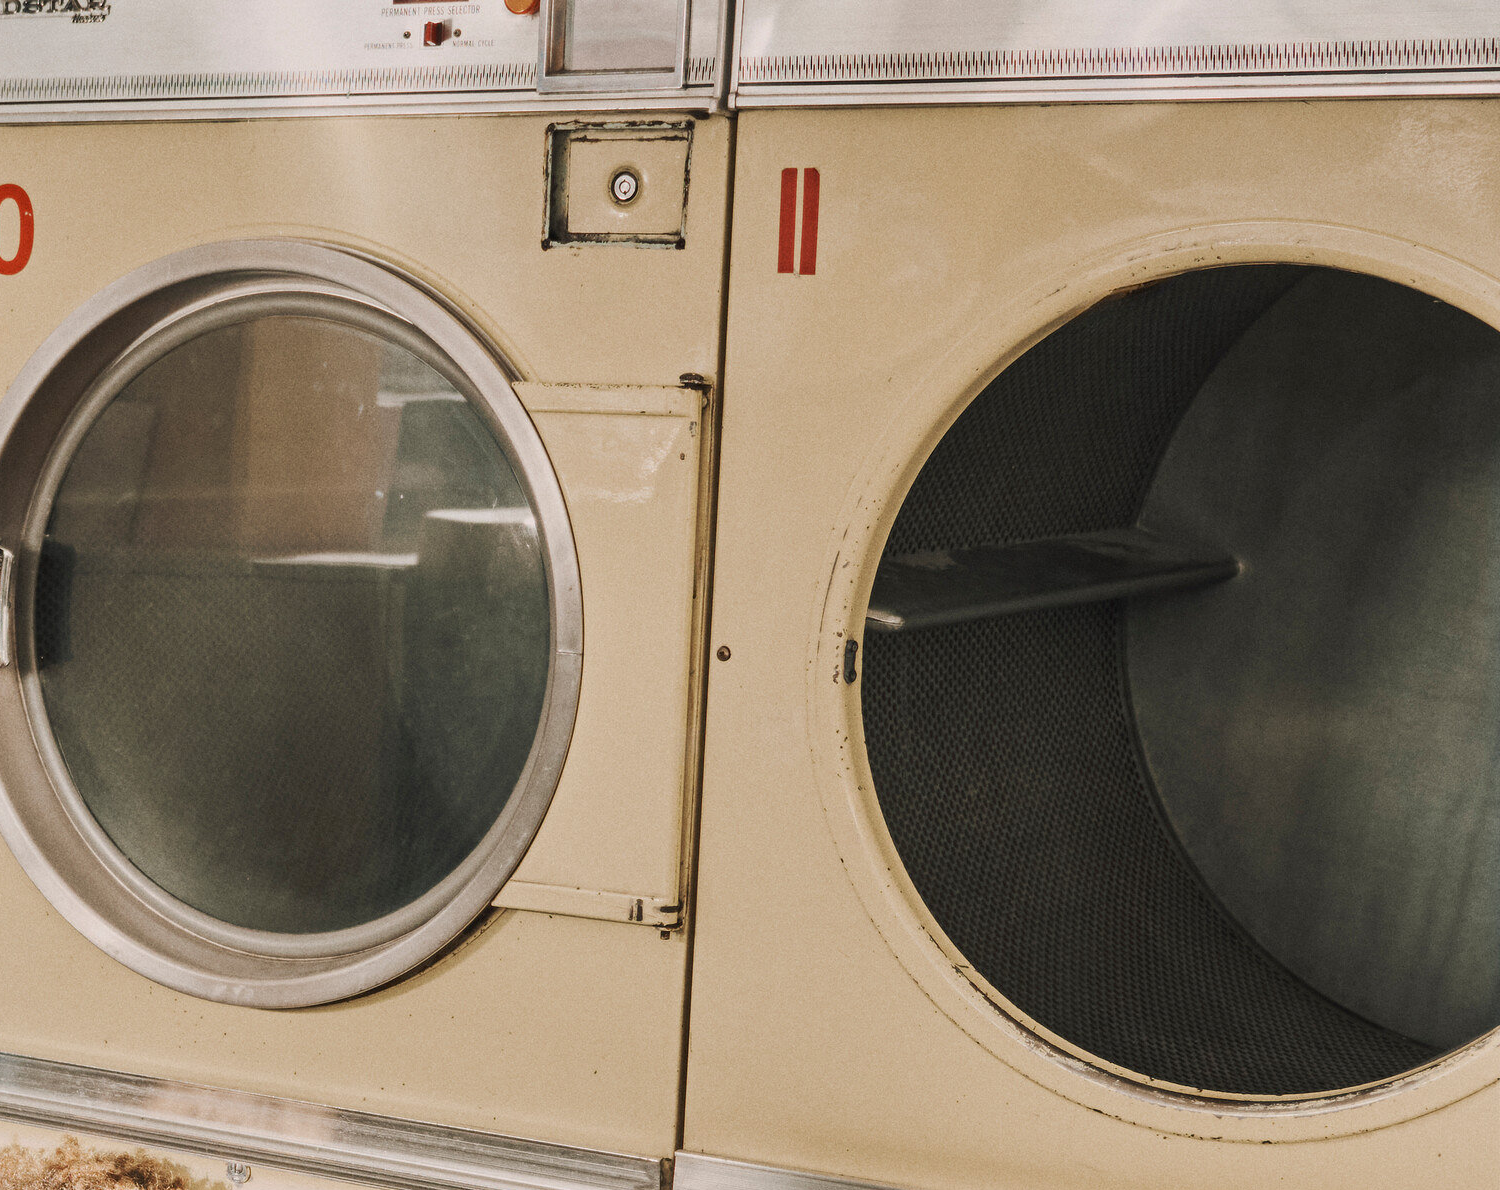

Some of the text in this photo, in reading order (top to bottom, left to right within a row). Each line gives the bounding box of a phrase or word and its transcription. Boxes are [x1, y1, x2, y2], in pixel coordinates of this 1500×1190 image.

[381, 4, 481, 17] PERMANENT PRESS SELECTOR
